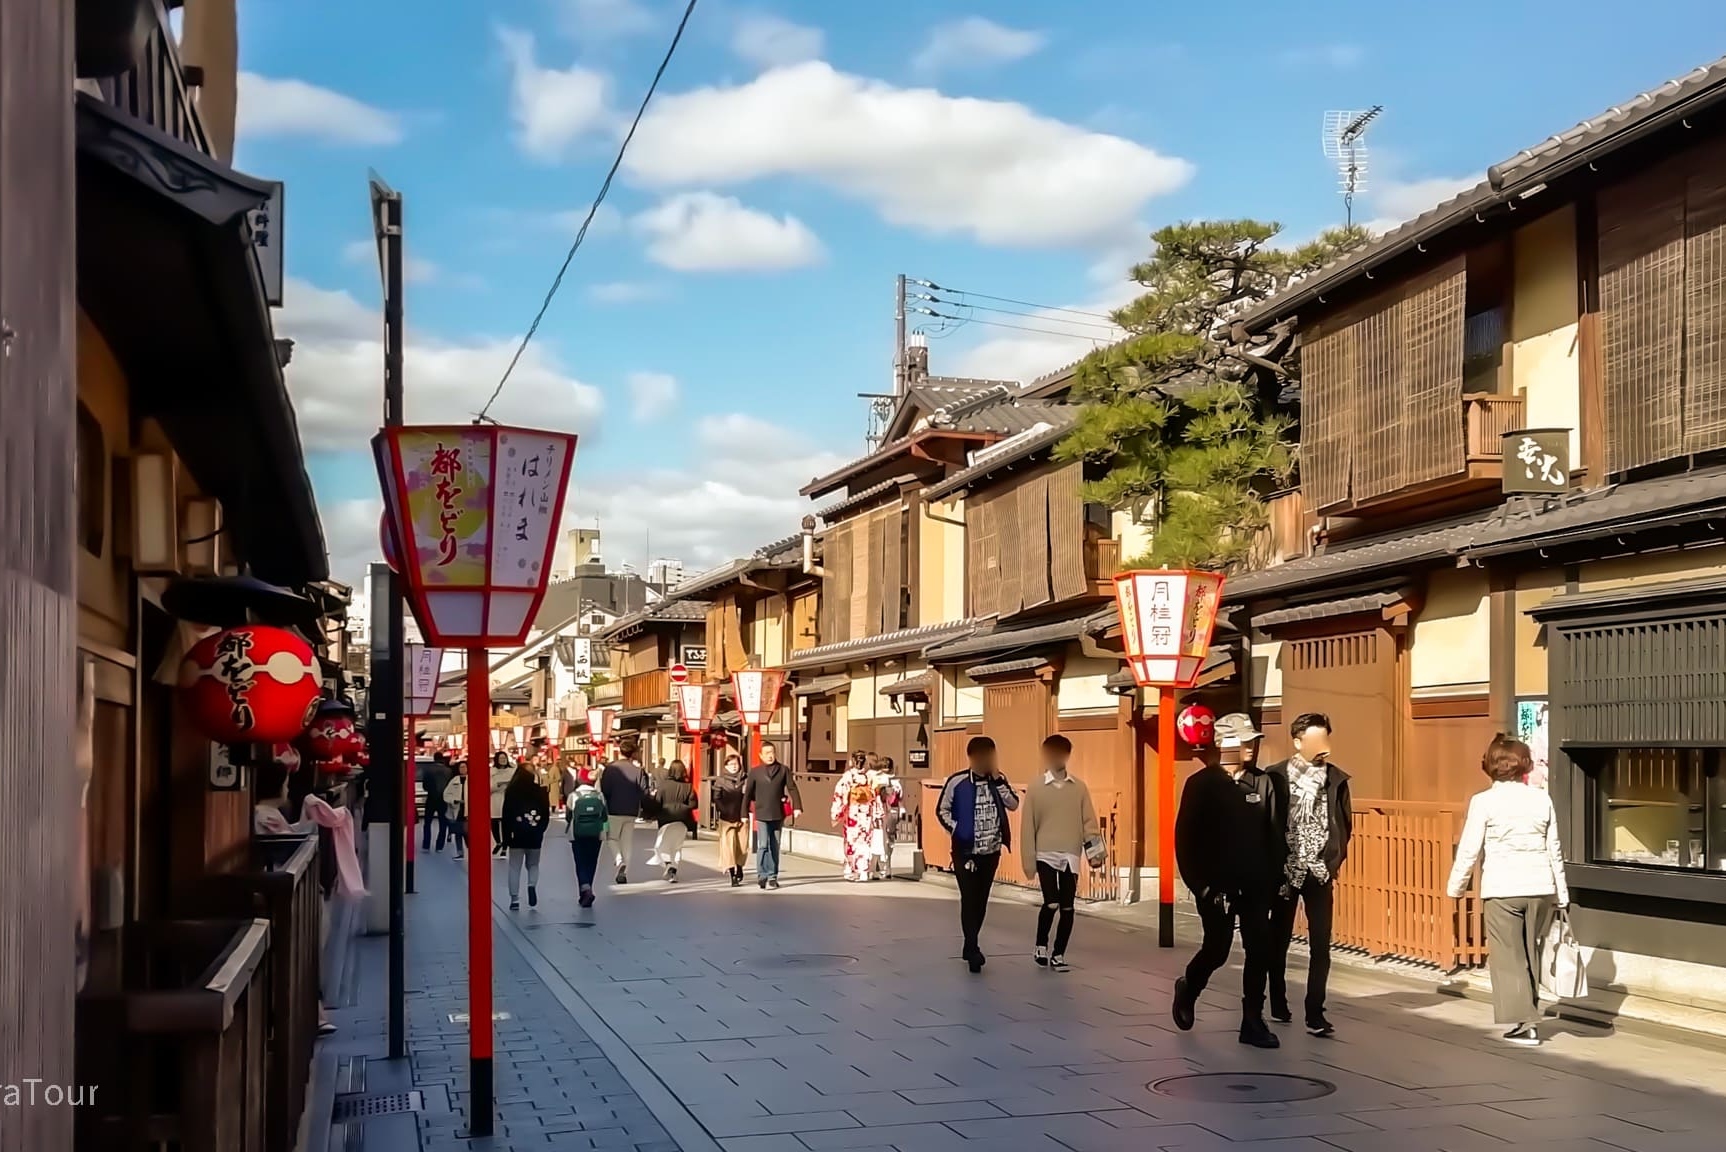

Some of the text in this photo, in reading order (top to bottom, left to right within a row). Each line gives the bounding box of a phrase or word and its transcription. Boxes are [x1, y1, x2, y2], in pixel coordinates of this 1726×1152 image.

[430, 442, 464, 567] 都をどり
[515, 455, 540, 541] はれま
[1150, 581, 1171, 646] 月桂冠
[214, 631, 256, 730] 都をどり
